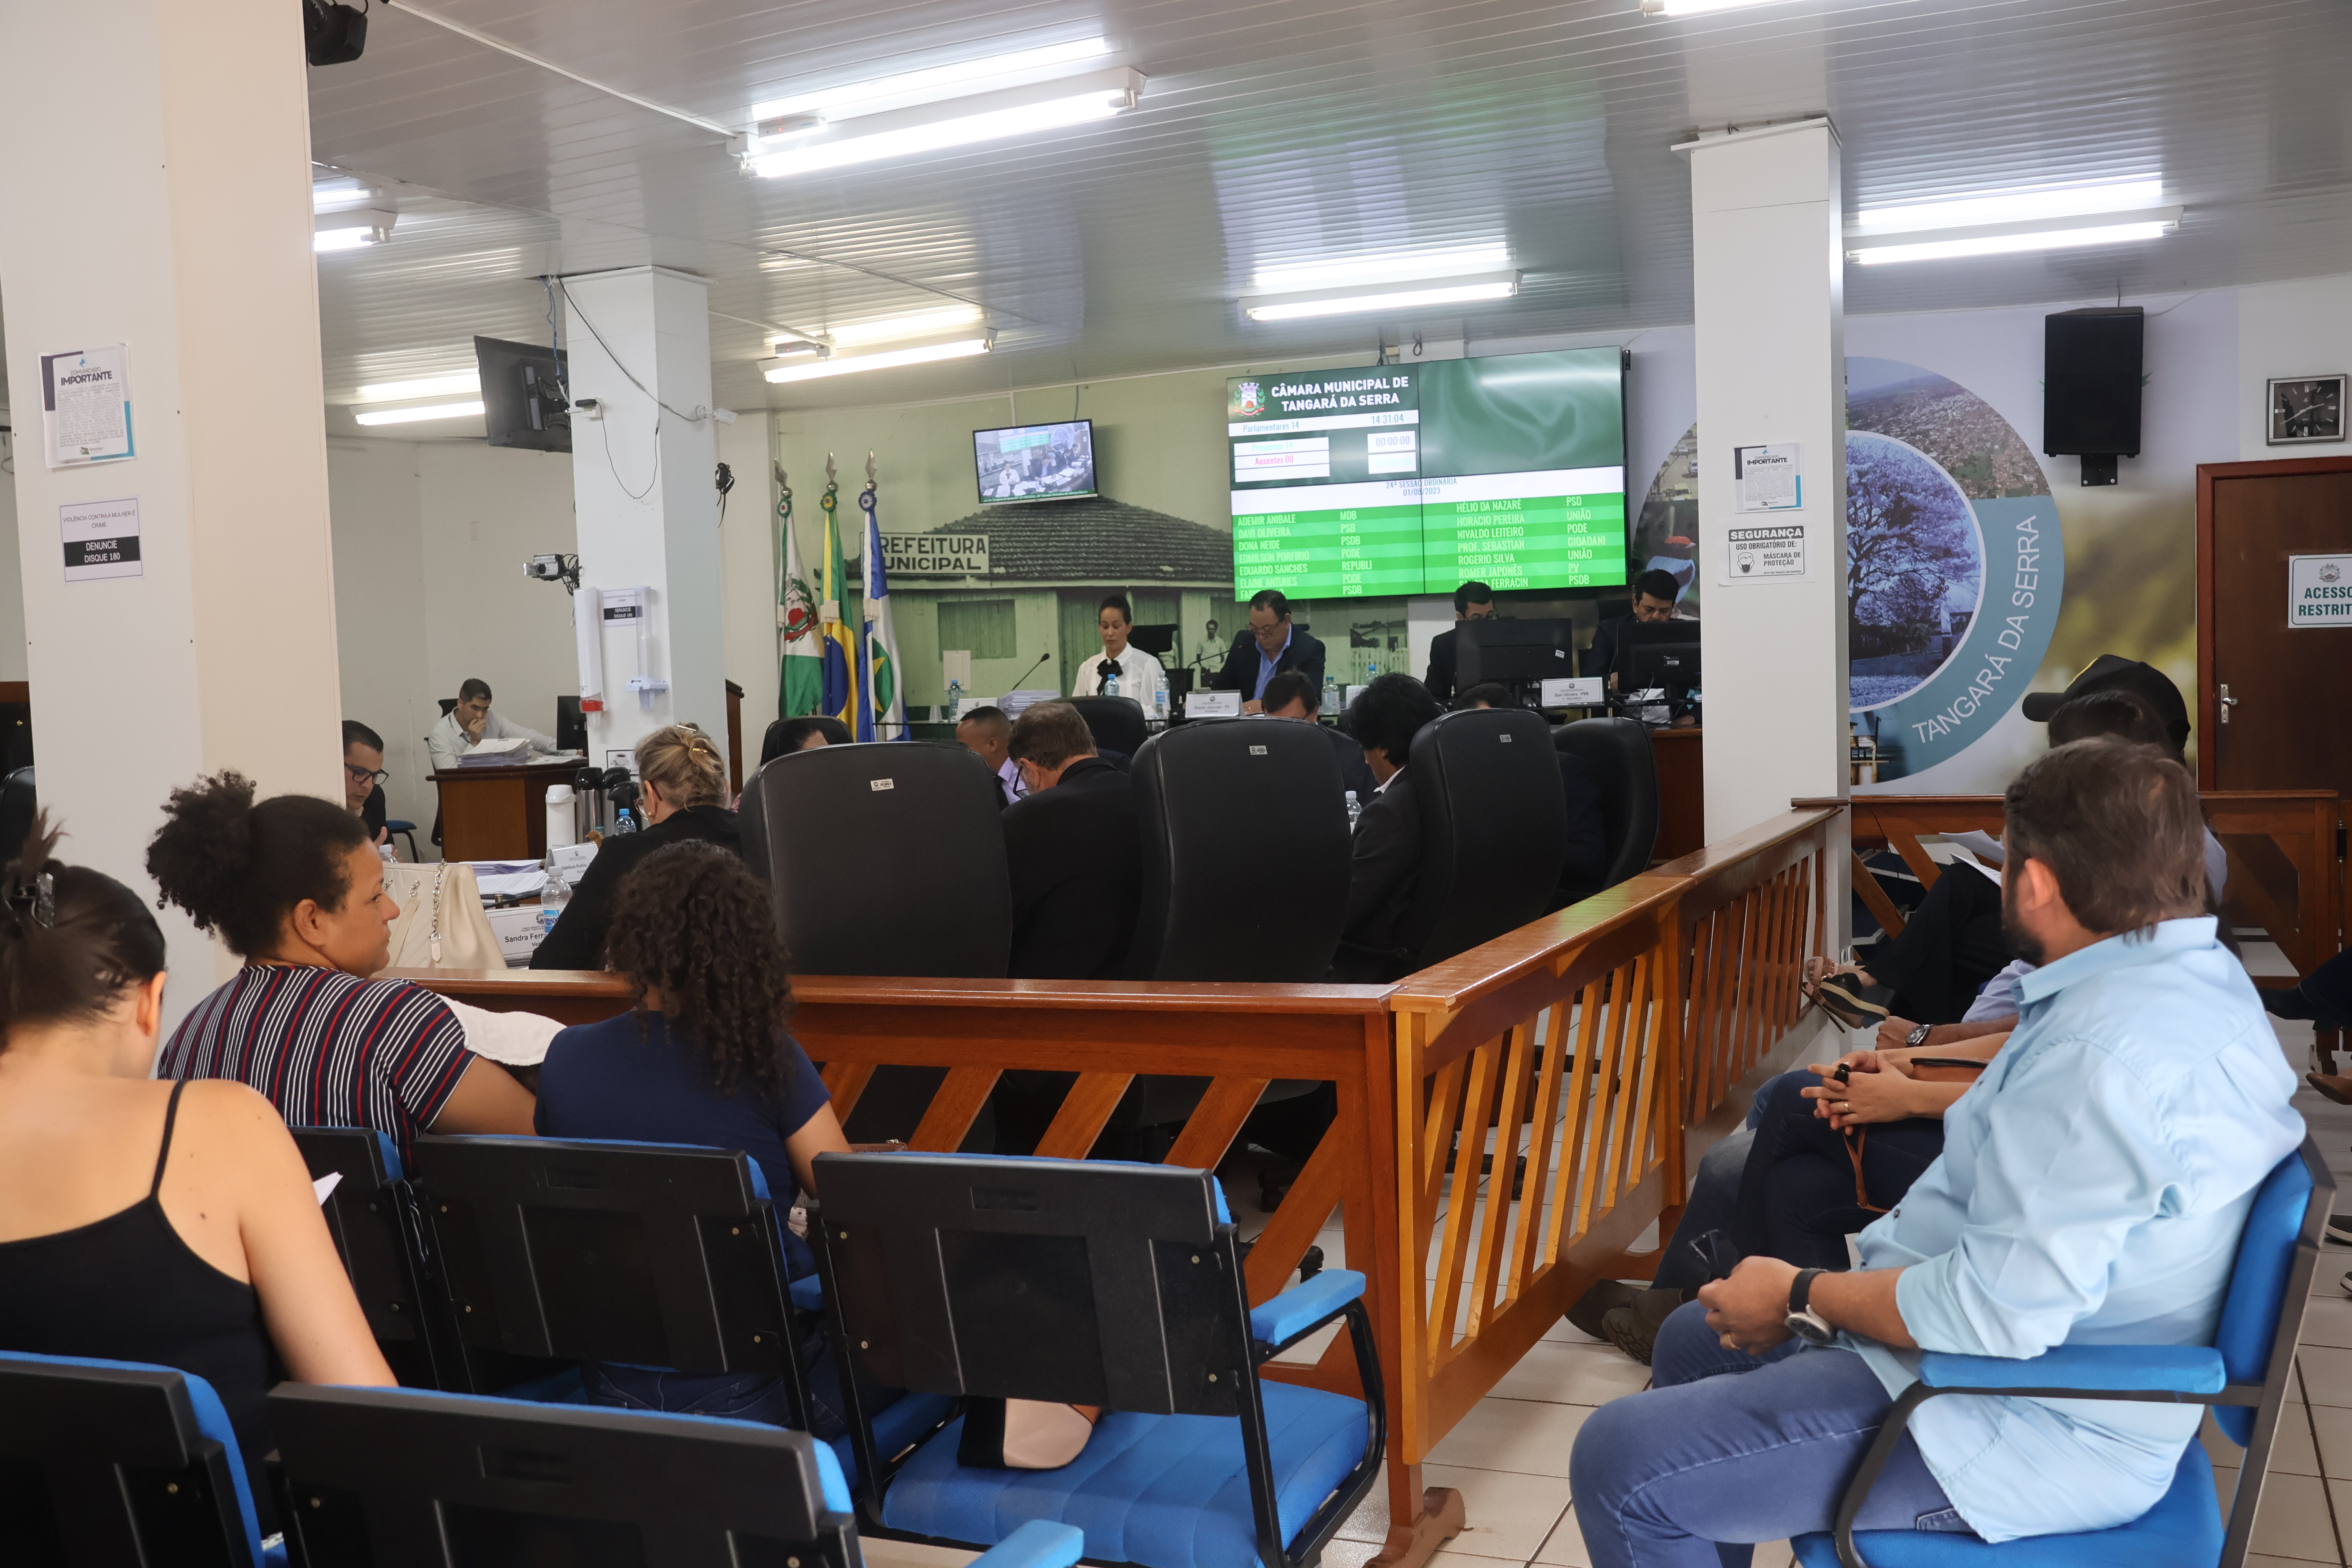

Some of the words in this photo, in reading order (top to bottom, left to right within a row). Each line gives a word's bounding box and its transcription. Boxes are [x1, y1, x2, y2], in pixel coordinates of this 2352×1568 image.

[70, 367, 101, 375] COMUNICADO
[61, 371, 113, 386] IMPORTANTE
[1271, 383, 1322, 397] CÂMARA
[1324, 378, 1390, 393] MUNICIPAL
[1393, 376, 1409, 387] DE
[1282, 394, 1338, 412] TANGARÁ
[1340, 396, 1357, 407] DA
[1359, 393, 1400, 405] SERRA
[1372, 414, 1404, 425] 14:31:04
[1243, 423, 1290, 433] Parlamentares
[1376, 436, 1410, 446] 00:00:00
[1252, 444, 1283, 452] Presentes
[1255, 457, 1284, 465] Ausentes
[1747, 457, 1788, 465] IMPORTANTE
[1424, 477, 1457, 486] ORDINARIA
[1403, 487, 1441, 496] 01/08/2023
[1456, 501, 1478, 513] HÉLIO
[1480, 502, 1490, 512] DA
[1492, 497, 1521, 510] NAZARÉ
[1566, 496, 1582, 506] PSD
[1238, 516, 1265, 526] ADEMIR
[1266, 514, 1296, 524] ANIBALE
[1340, 510, 1357, 521] MDB
[1457, 515, 1491, 526] HORACIO
[1494, 514, 1525, 525] PEREIRA
[1566, 508, 1591, 521] UNIÃO
[1238, 528, 1255, 539] DAVI
[1257, 526, 1291, 537] OLIVEIRA
[1341, 523, 1356, 533] PSB
[1457, 528, 1489, 539] NIVALDO
[1492, 526, 1524, 538] LEITEIRO
[1567, 523, 1588, 534] PODE
[1730, 528, 1802, 539] SEGURANÇA
[86, 540, 118, 551] DENUNCIE
[880, 537, 987, 554] REFEITURA
[1238, 541, 1258, 551] DONA
[1260, 539, 1280, 550] NEIDE
[1341, 535, 1360, 546] PSDB
[1458, 541, 1480, 553] PROF.
[1482, 539, 1525, 551] SEBASTIAN
[1568, 535, 1606, 547] CIDADANI
[1749, 540, 1786, 549] OBRIGATÓRIO
[84, 553, 108, 563] DISQUE
[110, 552, 120, 561] 180
[1239, 553, 1274, 564] EDMILSON
[1276, 551, 1309, 561] PORFIRIO
[1341, 548, 1360, 558] PODE
[1568, 548, 1592, 560] UNIÃO
[884, 557, 982, 570] UNICIPAL
[1458, 554, 1491, 565] ROGERIO
[1494, 553, 1515, 563] SILVA
[1764, 559, 1794, 567] PROTEÇÃO
[2012, 515, 2039, 608] SERRA
[1240, 565, 1273, 576] EDUARDO
[1275, 563, 1308, 573] SANCHES
[1342, 560, 1372, 571] REPUBLI
[1459, 568, 1486, 578] ROMER
[1488, 563, 1523, 577] JAPONÊS
[1568, 563, 1579, 573] PV
[1240, 578, 1264, 588] ELAINE
[1265, 576, 1298, 586] ANTUNES
[1342, 573, 1361, 583] PODE
[1492, 577, 1528, 588] FERRACIN
[1569, 575, 1590, 585] PSDB
[1343, 584, 1362, 595] PSDB
[2299, 604, 2352, 616] RESTRIT
[1998, 615, 2029, 650] DA
[1912, 653, 2012, 743] TANGARÁ
[505, 935, 528, 943] Sandra
